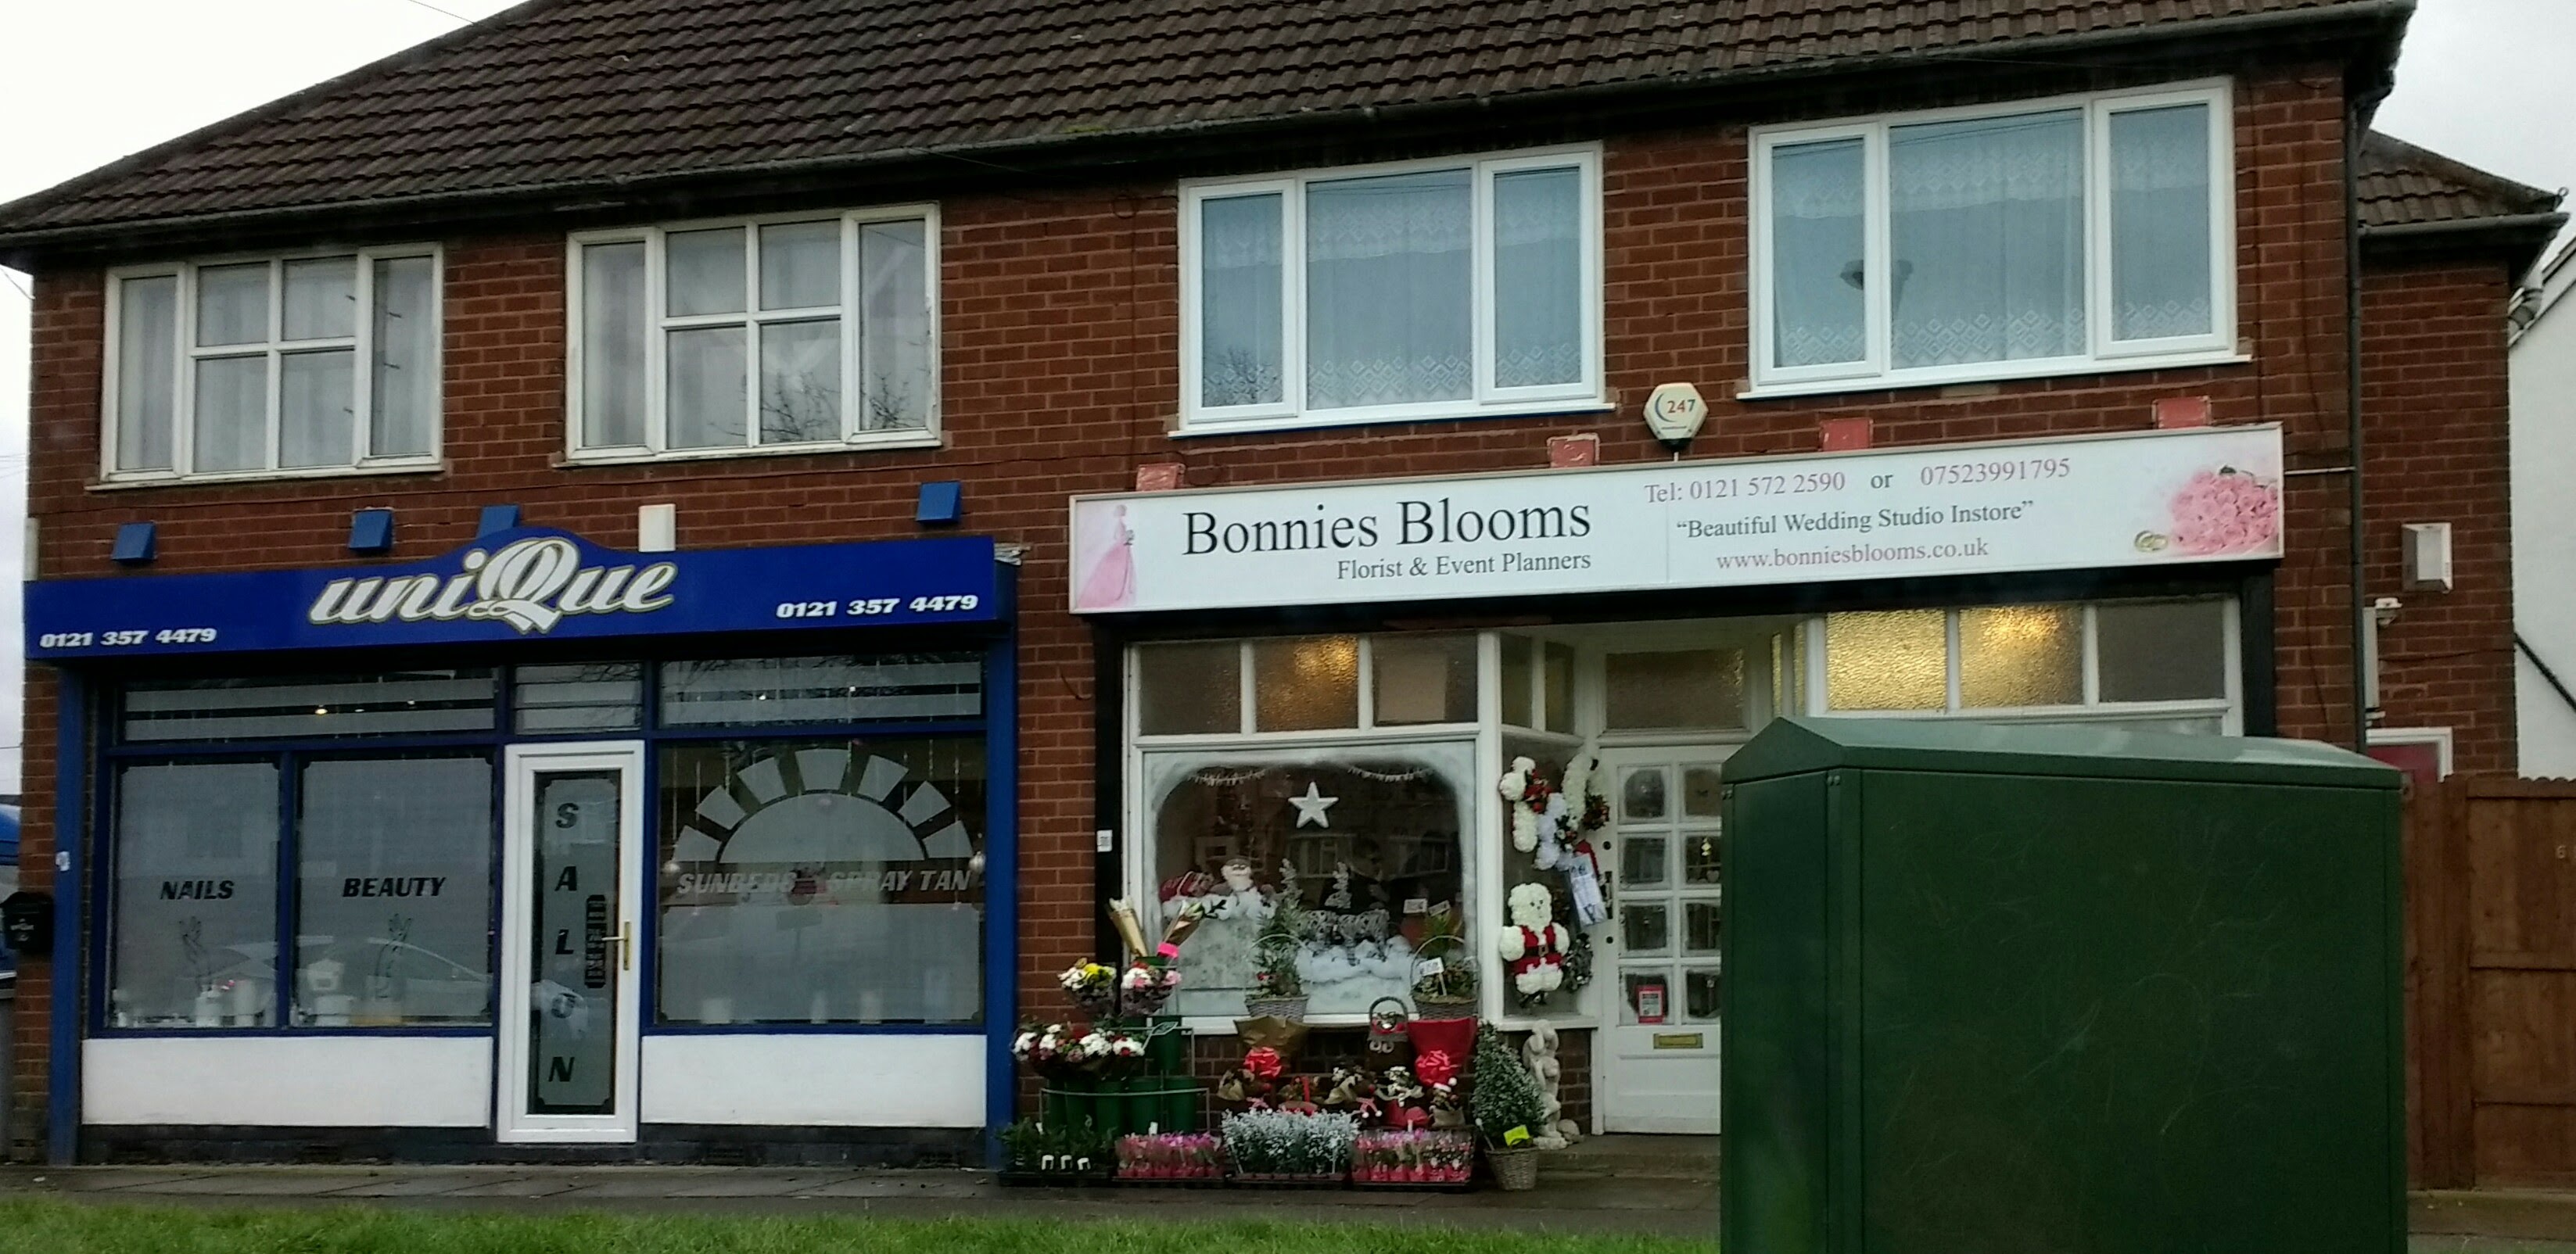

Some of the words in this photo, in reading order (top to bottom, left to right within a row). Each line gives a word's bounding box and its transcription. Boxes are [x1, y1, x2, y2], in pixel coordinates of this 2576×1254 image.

[1667, 398, 1696, 414] 247
[1644, 482, 1683, 503] Tel:
[1689, 478, 1738, 500] 0121
[1747, 475, 1785, 496] 572
[1792, 471, 1846, 493] 2590
[1870, 474, 1894, 489] or
[1920, 457, 2071, 485] 07523991795
[1182, 503, 1379, 556] Bonnies
[1396, 497, 1591, 546] Blooms
[1783, 511, 1873, 533] Wedding
[1878, 506, 1945, 528] Studio
[1717, 537, 1989, 569] www.bonniesblooms.co.uk
[1337, 558, 1403, 580] Florist
[1408, 557, 1428, 577] &
[1435, 555, 1495, 576] Event
[1501, 552, 1592, 572] Planners
[776, 600, 838, 618] 0121
[846, 597, 900, 615] 357
[909, 594, 979, 612] 4479
[39, 632, 94, 649] 0121
[100, 630, 149, 646] 357
[155, 628, 217, 644] 4479
[160, 880, 235, 901] NAILS
[342, 876, 447, 898] BEAUTY
[827, 869, 913, 894] SPRAY
[919, 869, 972, 891] TAN
